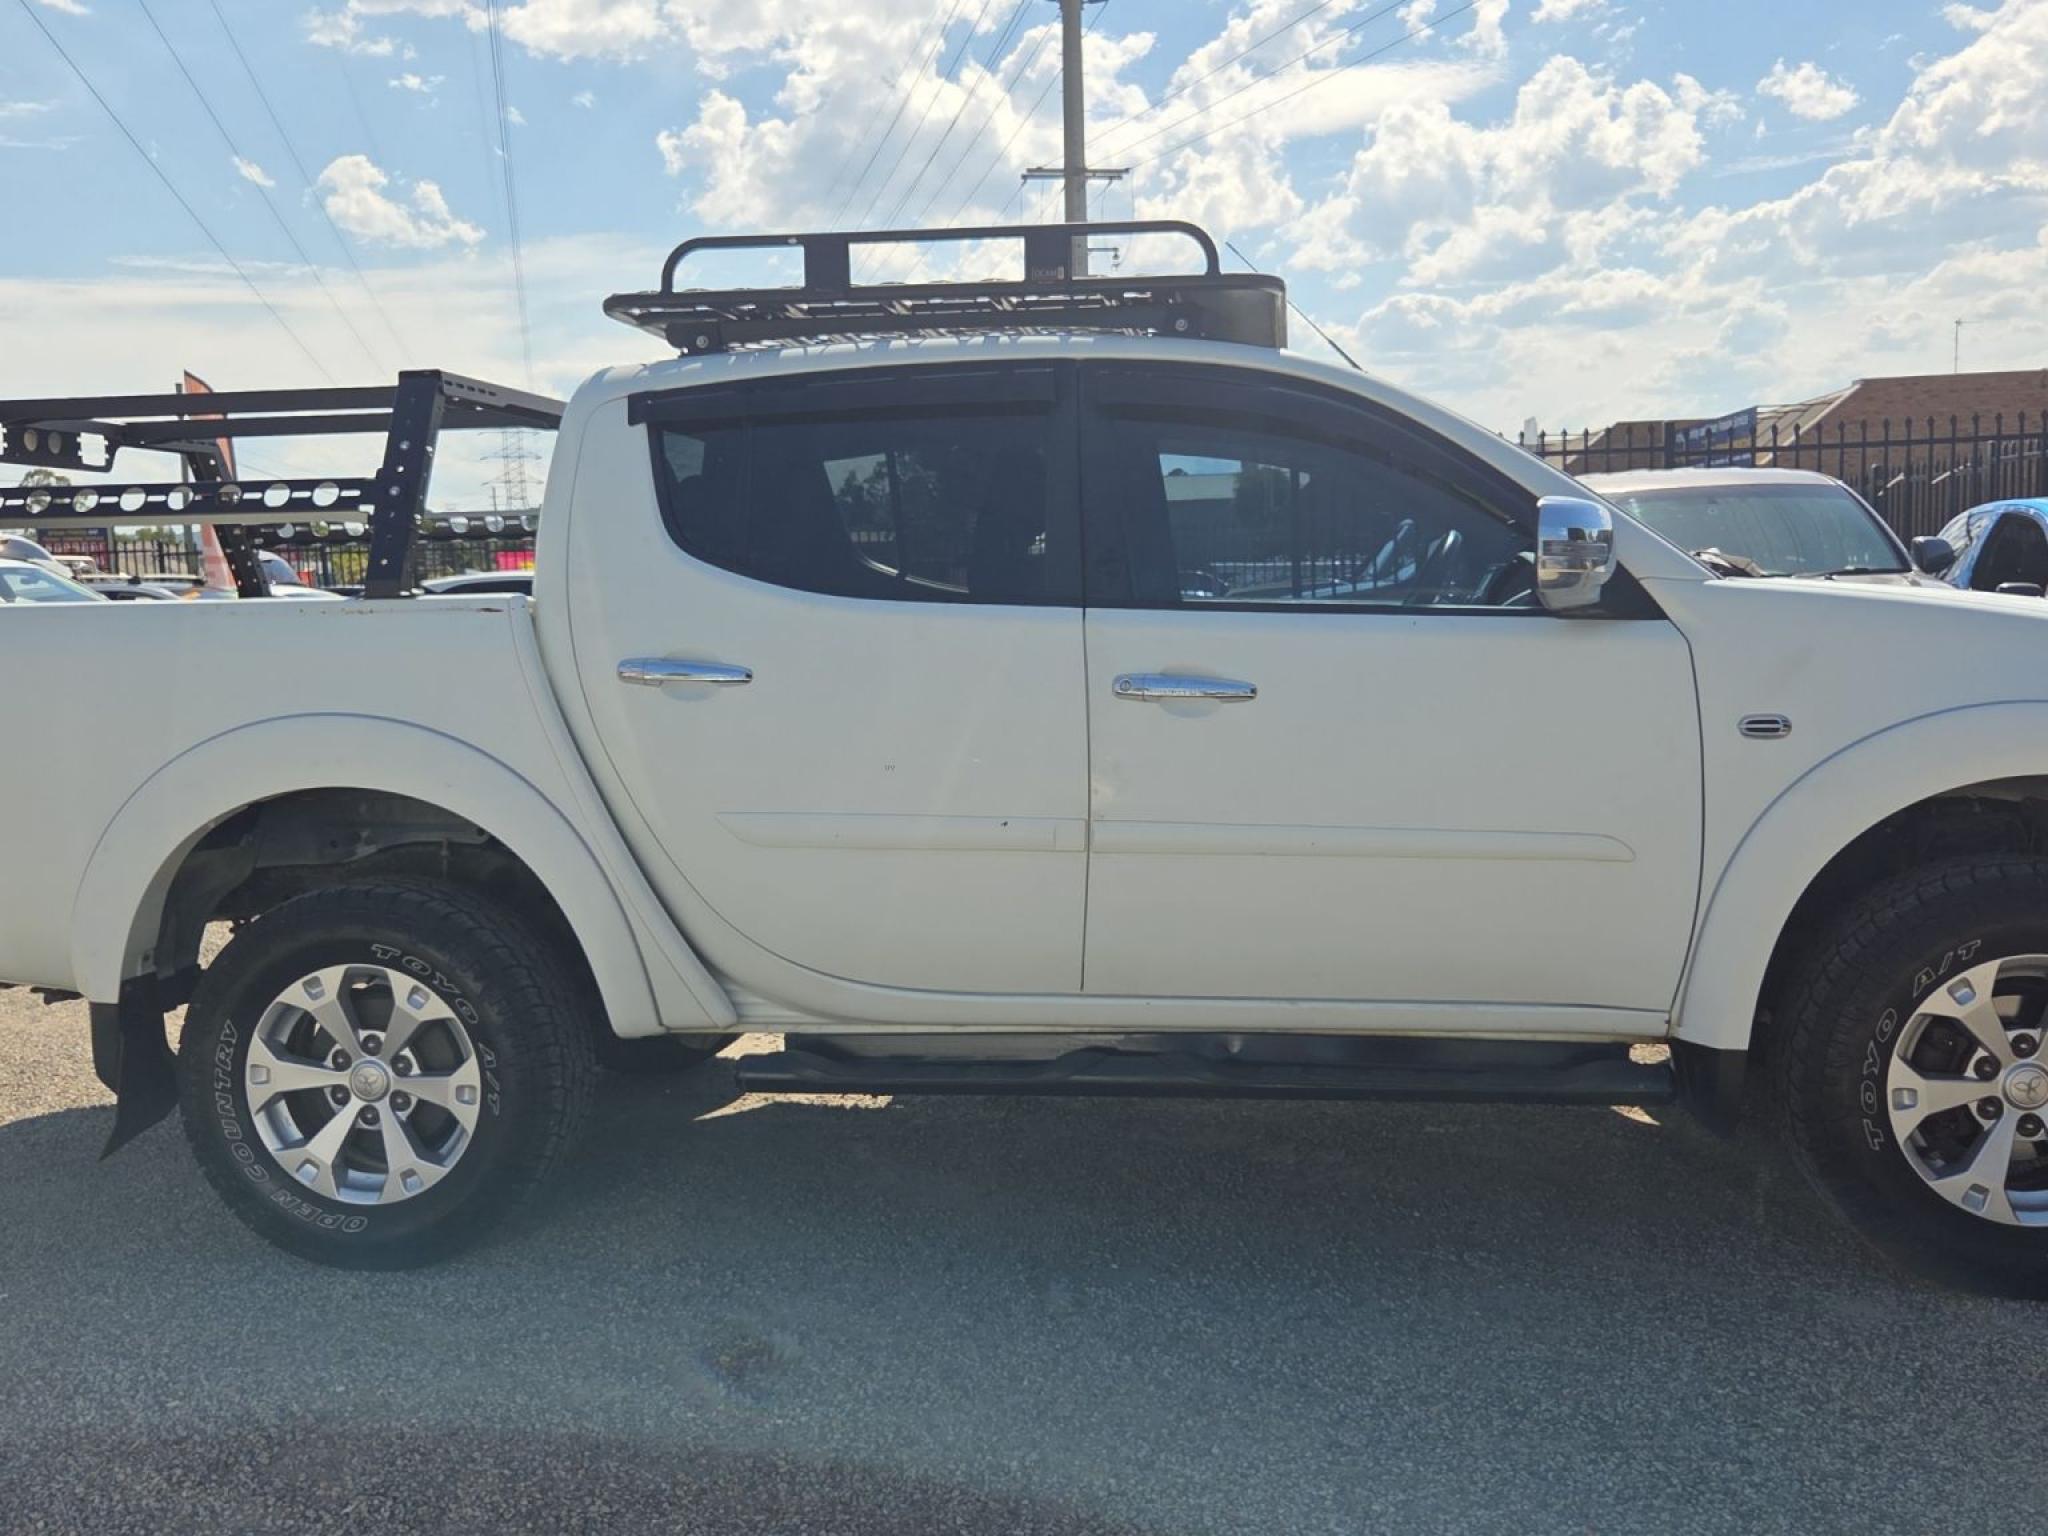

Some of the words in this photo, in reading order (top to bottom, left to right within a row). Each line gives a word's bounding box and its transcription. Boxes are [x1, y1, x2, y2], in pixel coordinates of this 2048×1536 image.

[213, 1018, 270, 1183] COUNTRY
[371, 943, 479, 1024] TOYO
[478, 1041, 500, 1116] A/T
[1860, 1007, 1898, 1151] TOYO
[1912, 939, 1982, 998] A/T
[270, 1187, 368, 1233] OPEN
